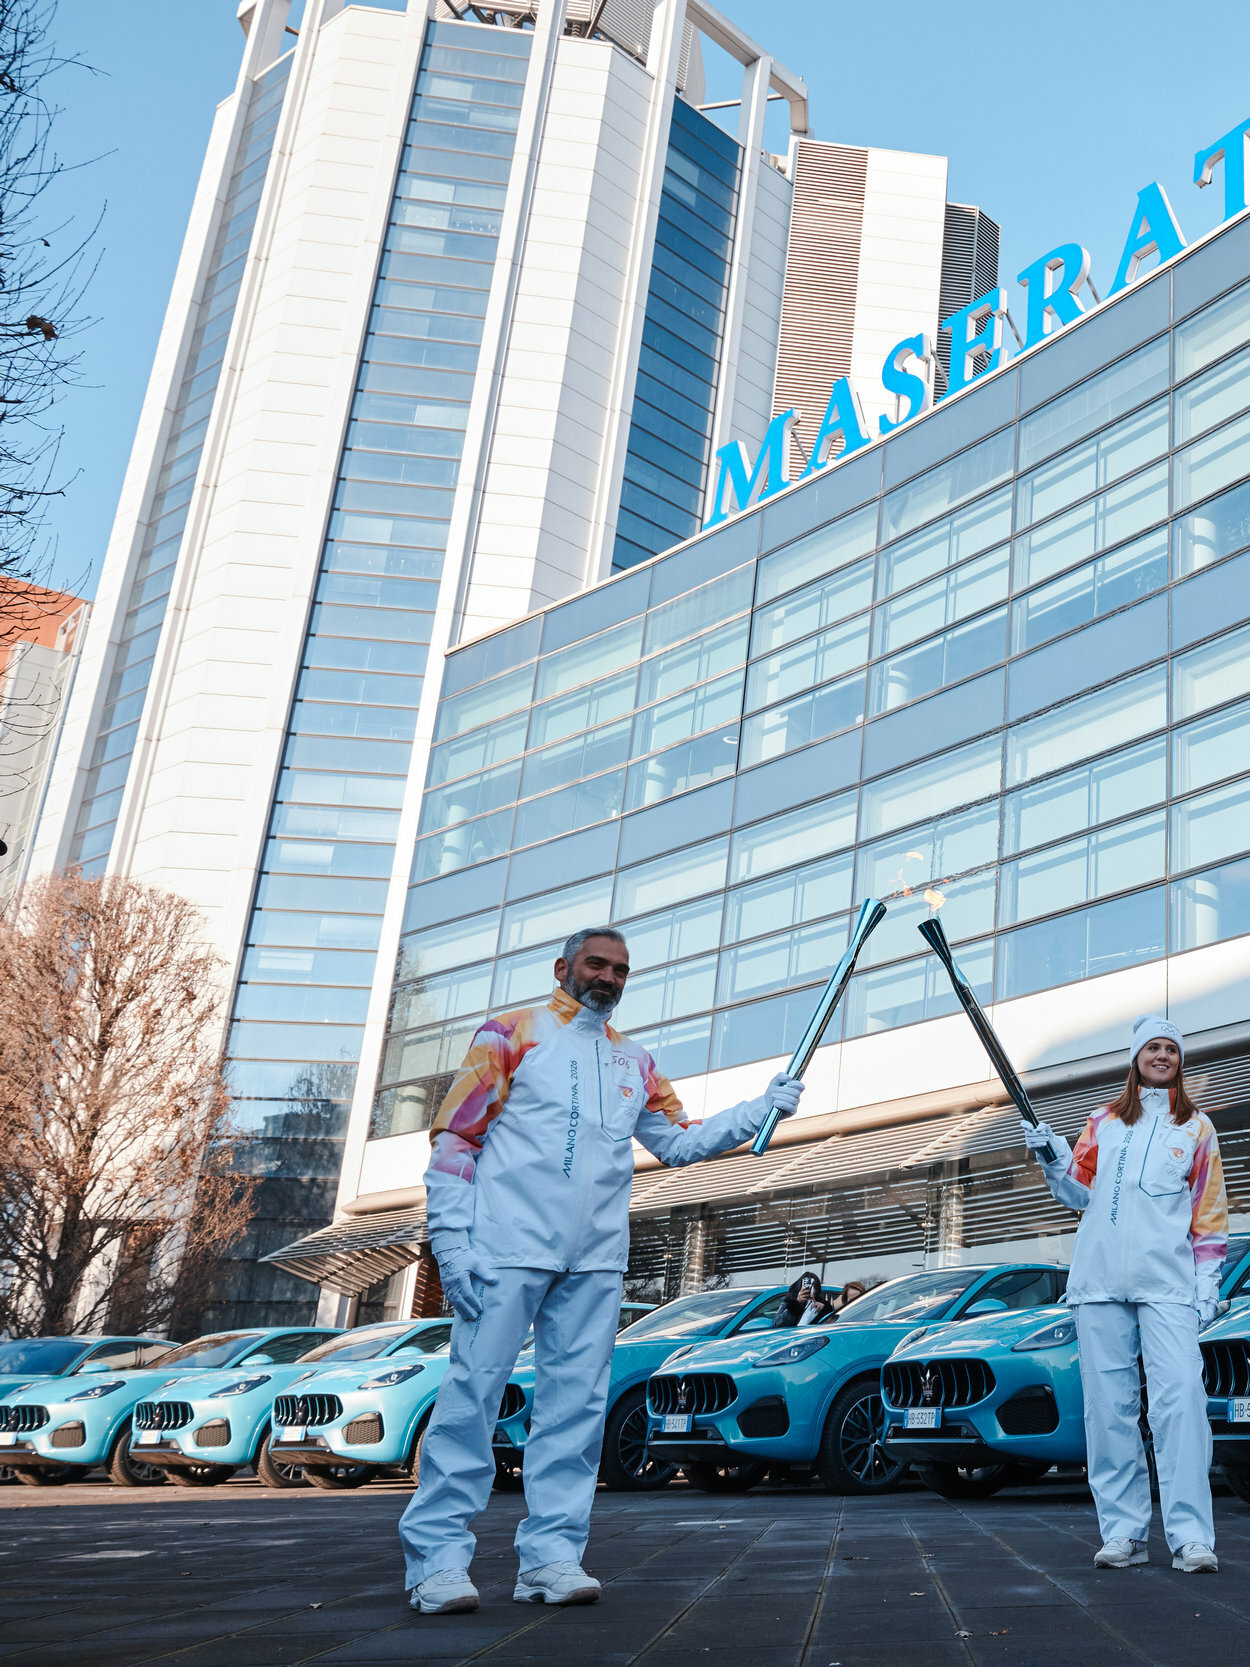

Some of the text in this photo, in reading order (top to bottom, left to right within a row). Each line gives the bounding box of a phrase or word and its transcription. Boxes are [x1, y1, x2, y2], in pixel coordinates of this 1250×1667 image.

[563, 1060, 580, 1179] MILANO CORTINA 2026
[1110, 1129, 1134, 1226] MILANO CORTINA 2026
